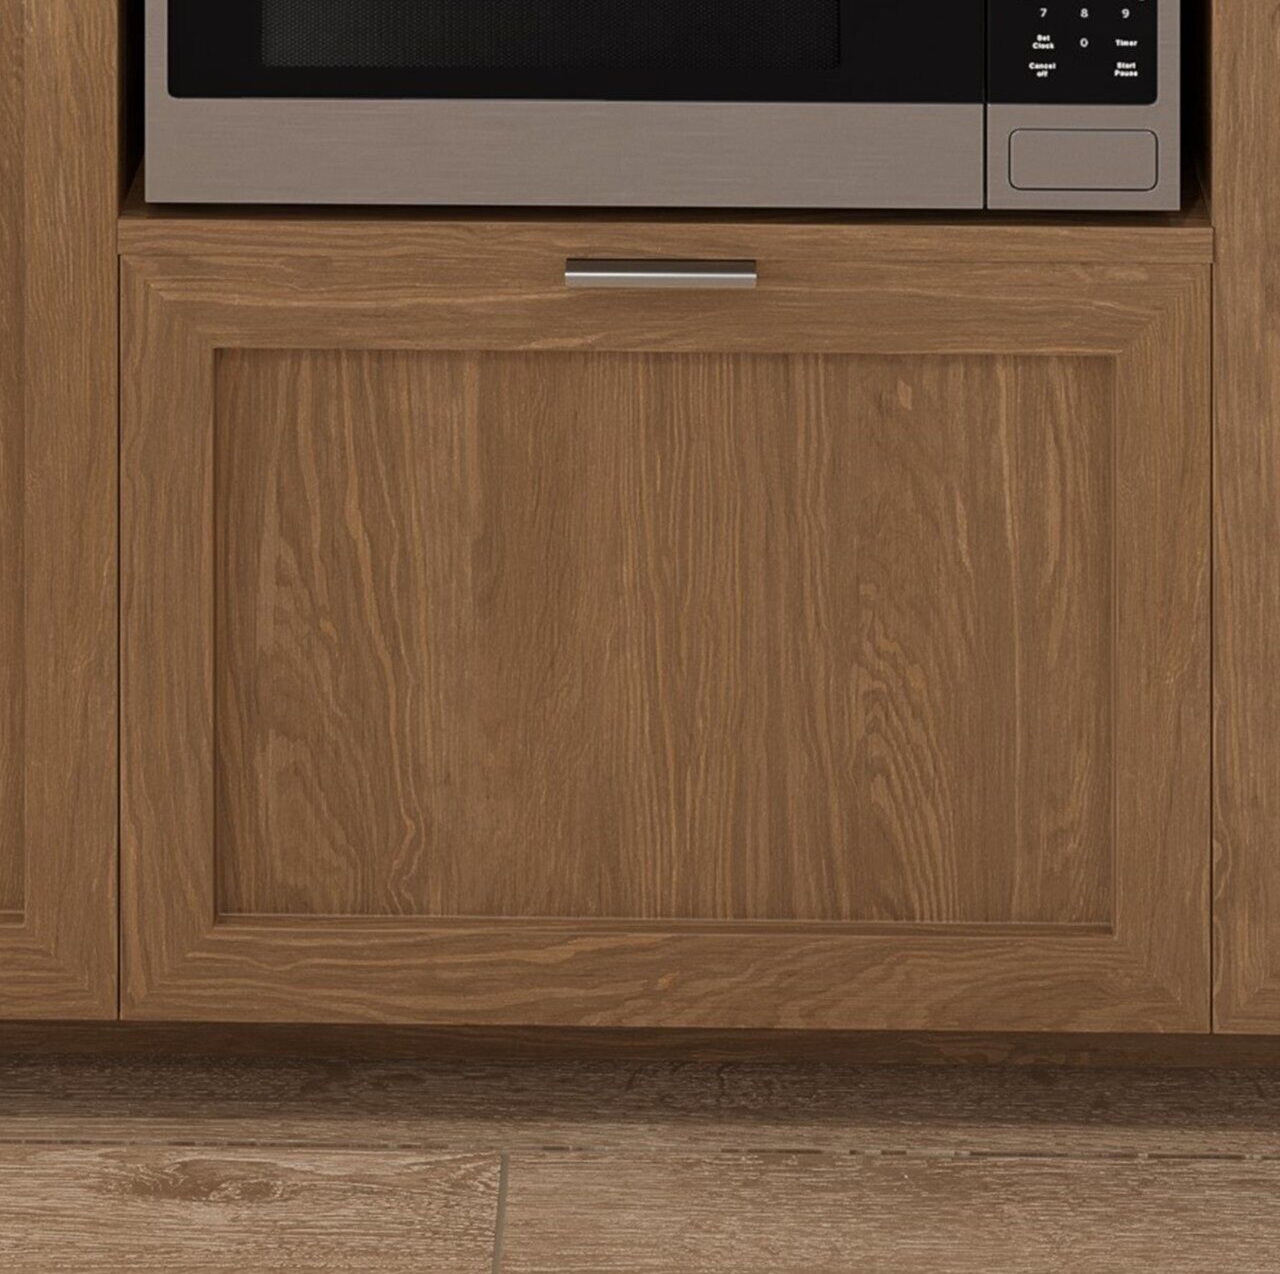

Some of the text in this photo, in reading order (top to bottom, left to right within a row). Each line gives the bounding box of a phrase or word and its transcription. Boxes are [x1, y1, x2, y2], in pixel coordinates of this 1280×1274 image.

[1040, 8, 1047, 18] 7
[1080, 8, 1089, 18] 8
[1122, 8, 1130, 18] 9
[1115, 39, 1137, 47] Timer
[1114, 69, 1138, 77] Pause
